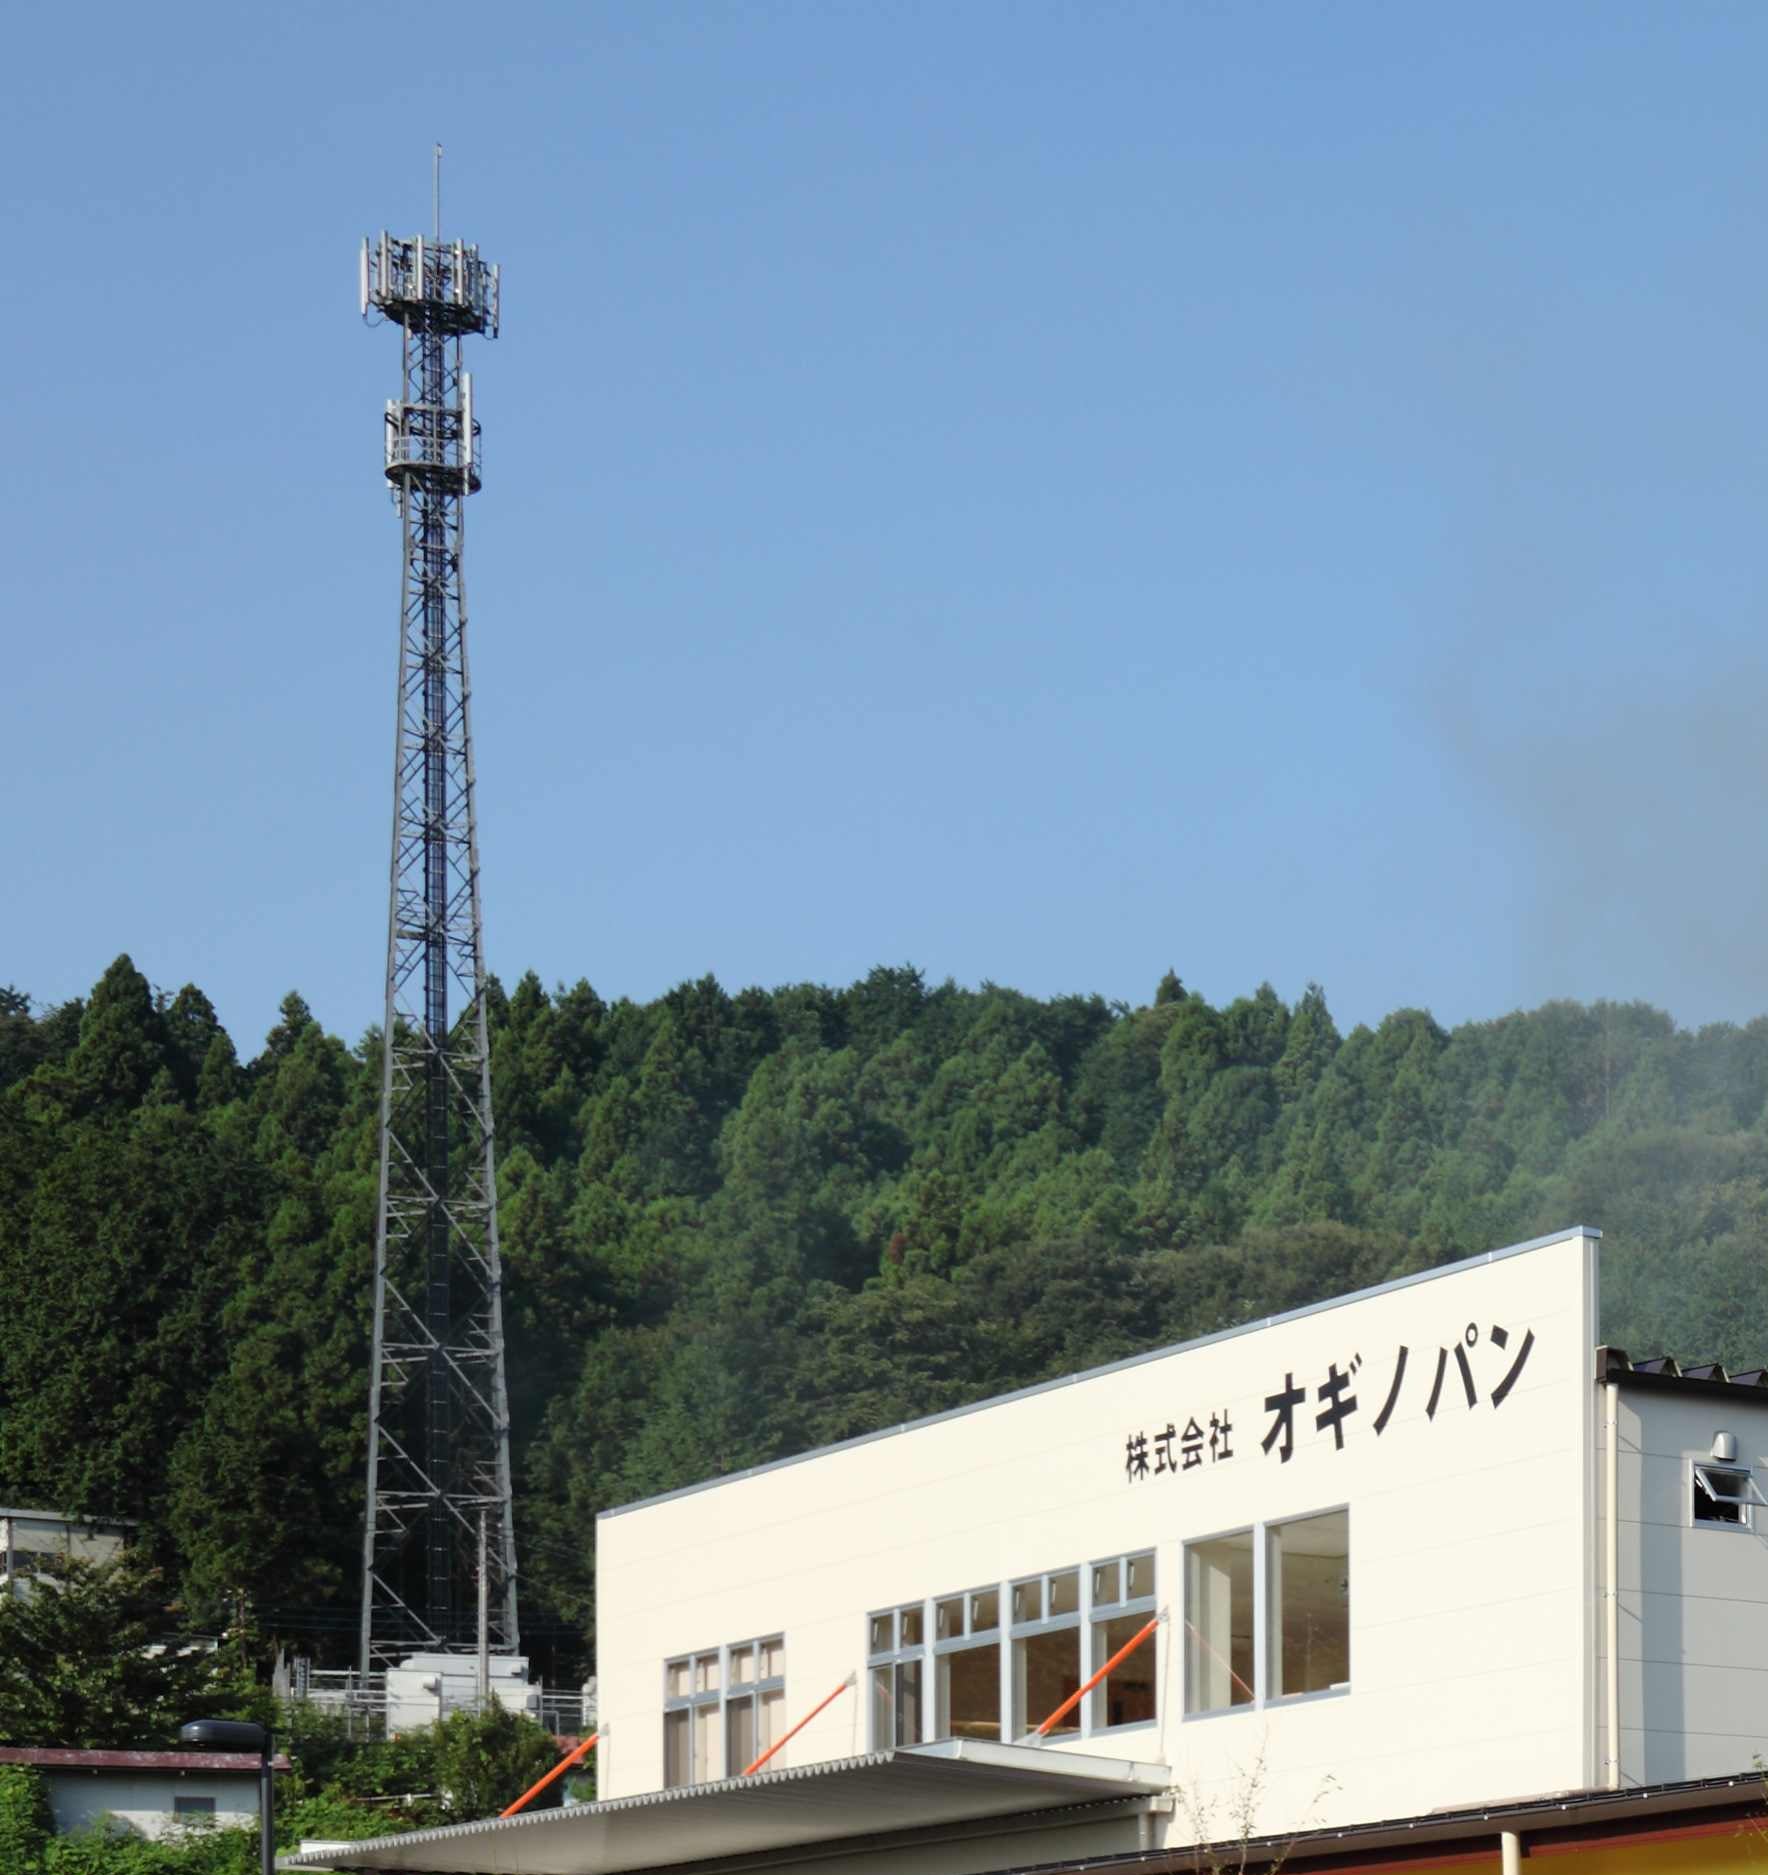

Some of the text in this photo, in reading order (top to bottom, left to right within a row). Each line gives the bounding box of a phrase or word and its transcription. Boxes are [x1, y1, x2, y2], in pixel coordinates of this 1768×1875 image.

[1125, 1322, 1535, 1483] 株式会社 オギノパン
